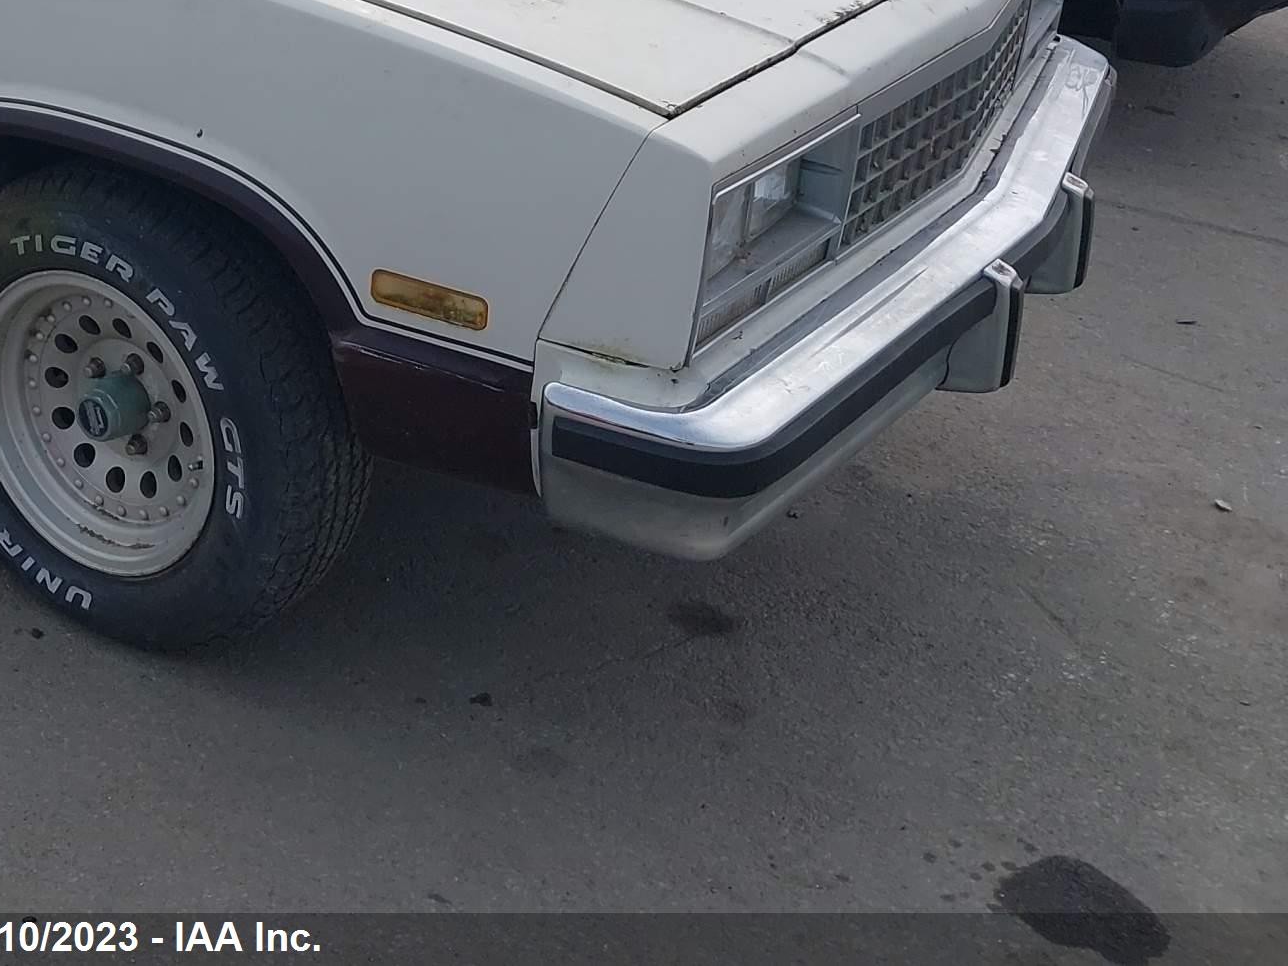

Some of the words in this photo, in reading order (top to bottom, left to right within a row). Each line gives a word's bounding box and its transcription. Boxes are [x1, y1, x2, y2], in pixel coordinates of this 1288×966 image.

[10, 234, 134, 283] TIGER
[145, 288, 225, 391] PAW
[220, 417, 245, 520] GTS
